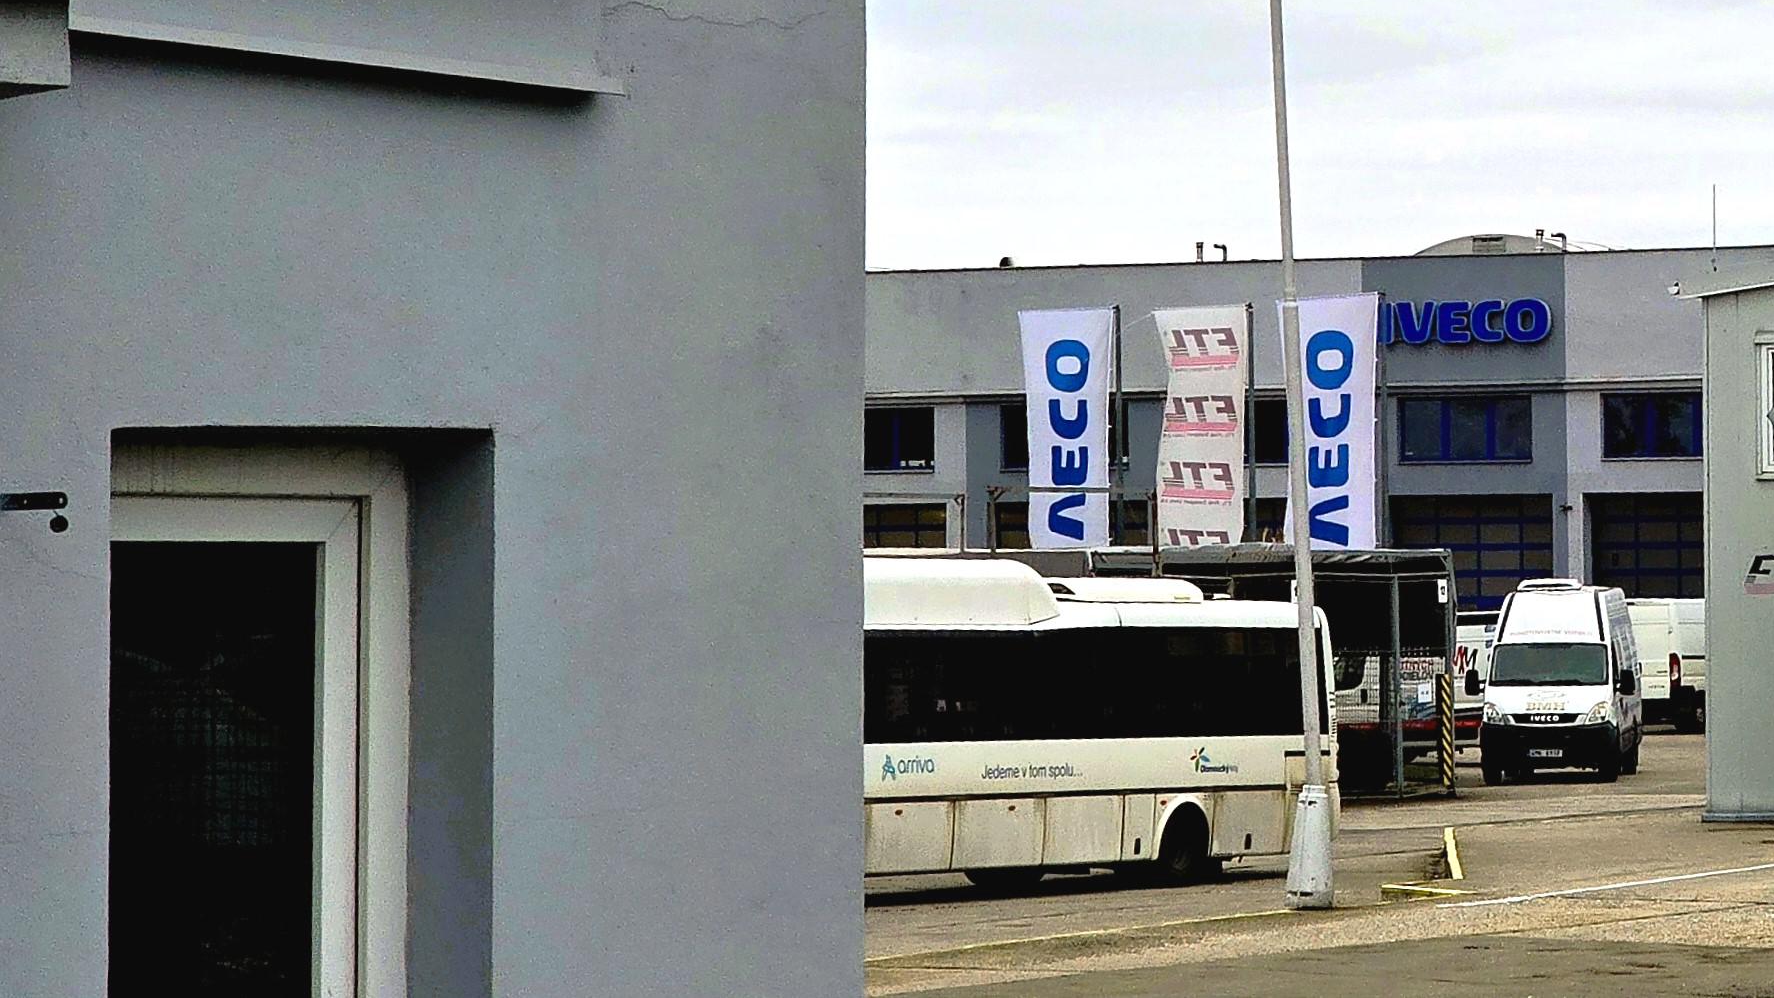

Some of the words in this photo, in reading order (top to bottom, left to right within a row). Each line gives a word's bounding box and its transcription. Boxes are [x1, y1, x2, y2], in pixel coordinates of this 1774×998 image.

[1377, 297, 1551, 345] IVECO
[1530, 714, 1560, 722] IVECO
[897, 755, 935, 774] arriva
[981, 764, 1020, 779] Jedeme
[1021, 767, 1027, 778] v
[1029, 765, 1047, 778] tom
[1048, 762, 1083, 780] spolu...
